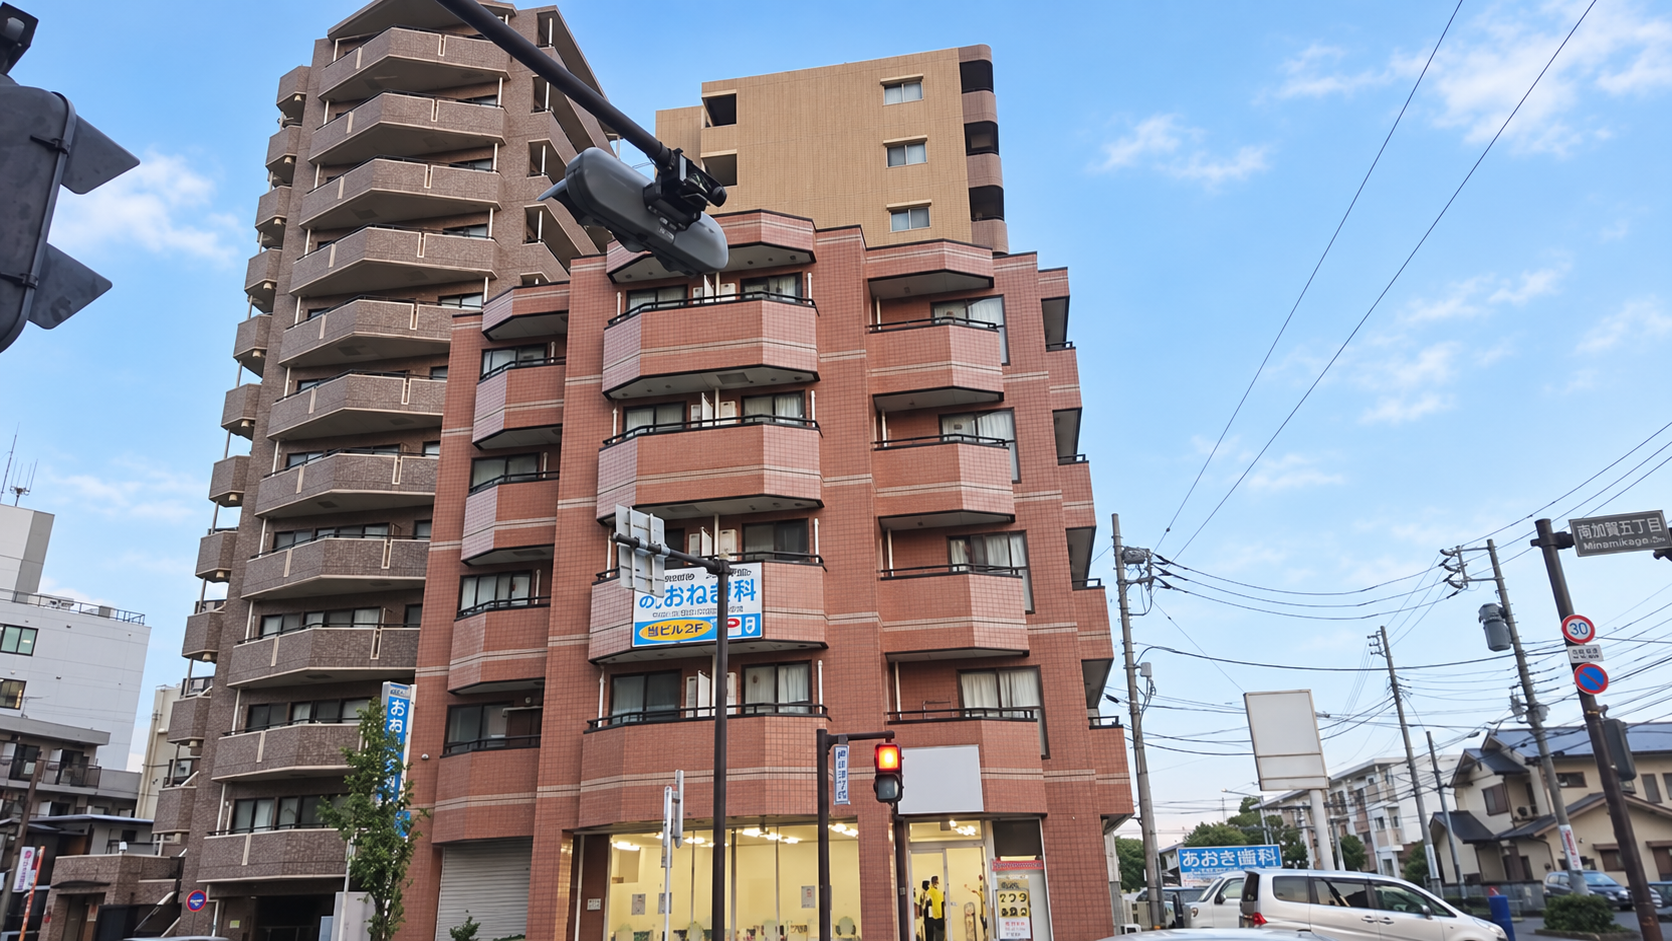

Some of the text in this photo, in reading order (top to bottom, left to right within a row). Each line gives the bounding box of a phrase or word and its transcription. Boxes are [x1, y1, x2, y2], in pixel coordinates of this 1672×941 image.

[1569, 622, 1588, 635] 30
[1182, 848, 1277, 867] あおき歯科
